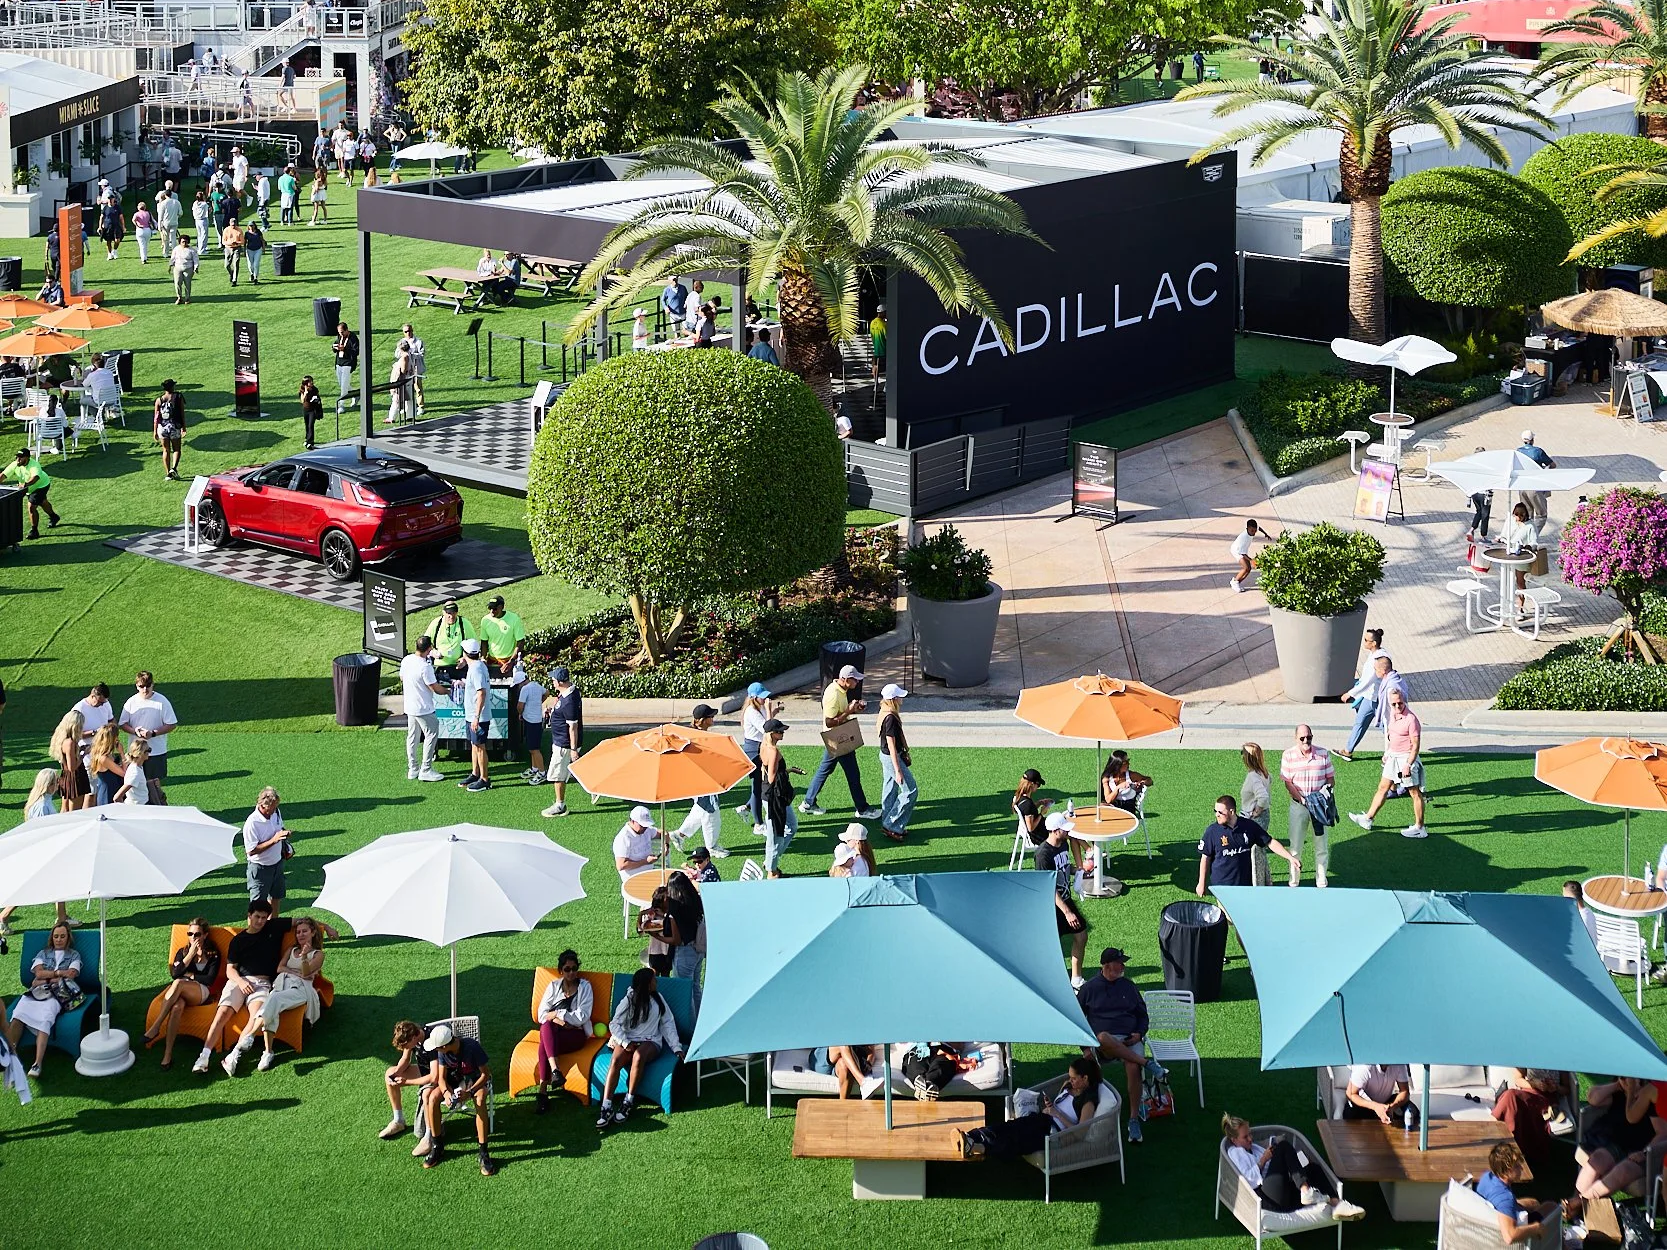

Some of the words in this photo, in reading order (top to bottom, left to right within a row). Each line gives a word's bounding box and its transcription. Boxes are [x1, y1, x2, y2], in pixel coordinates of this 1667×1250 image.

[58, 103, 78, 125] MIAMI
[83, 95, 100, 116] SLICE
[919, 262, 1218, 376] CADILLAC
[451, 709, 466, 717] COL
